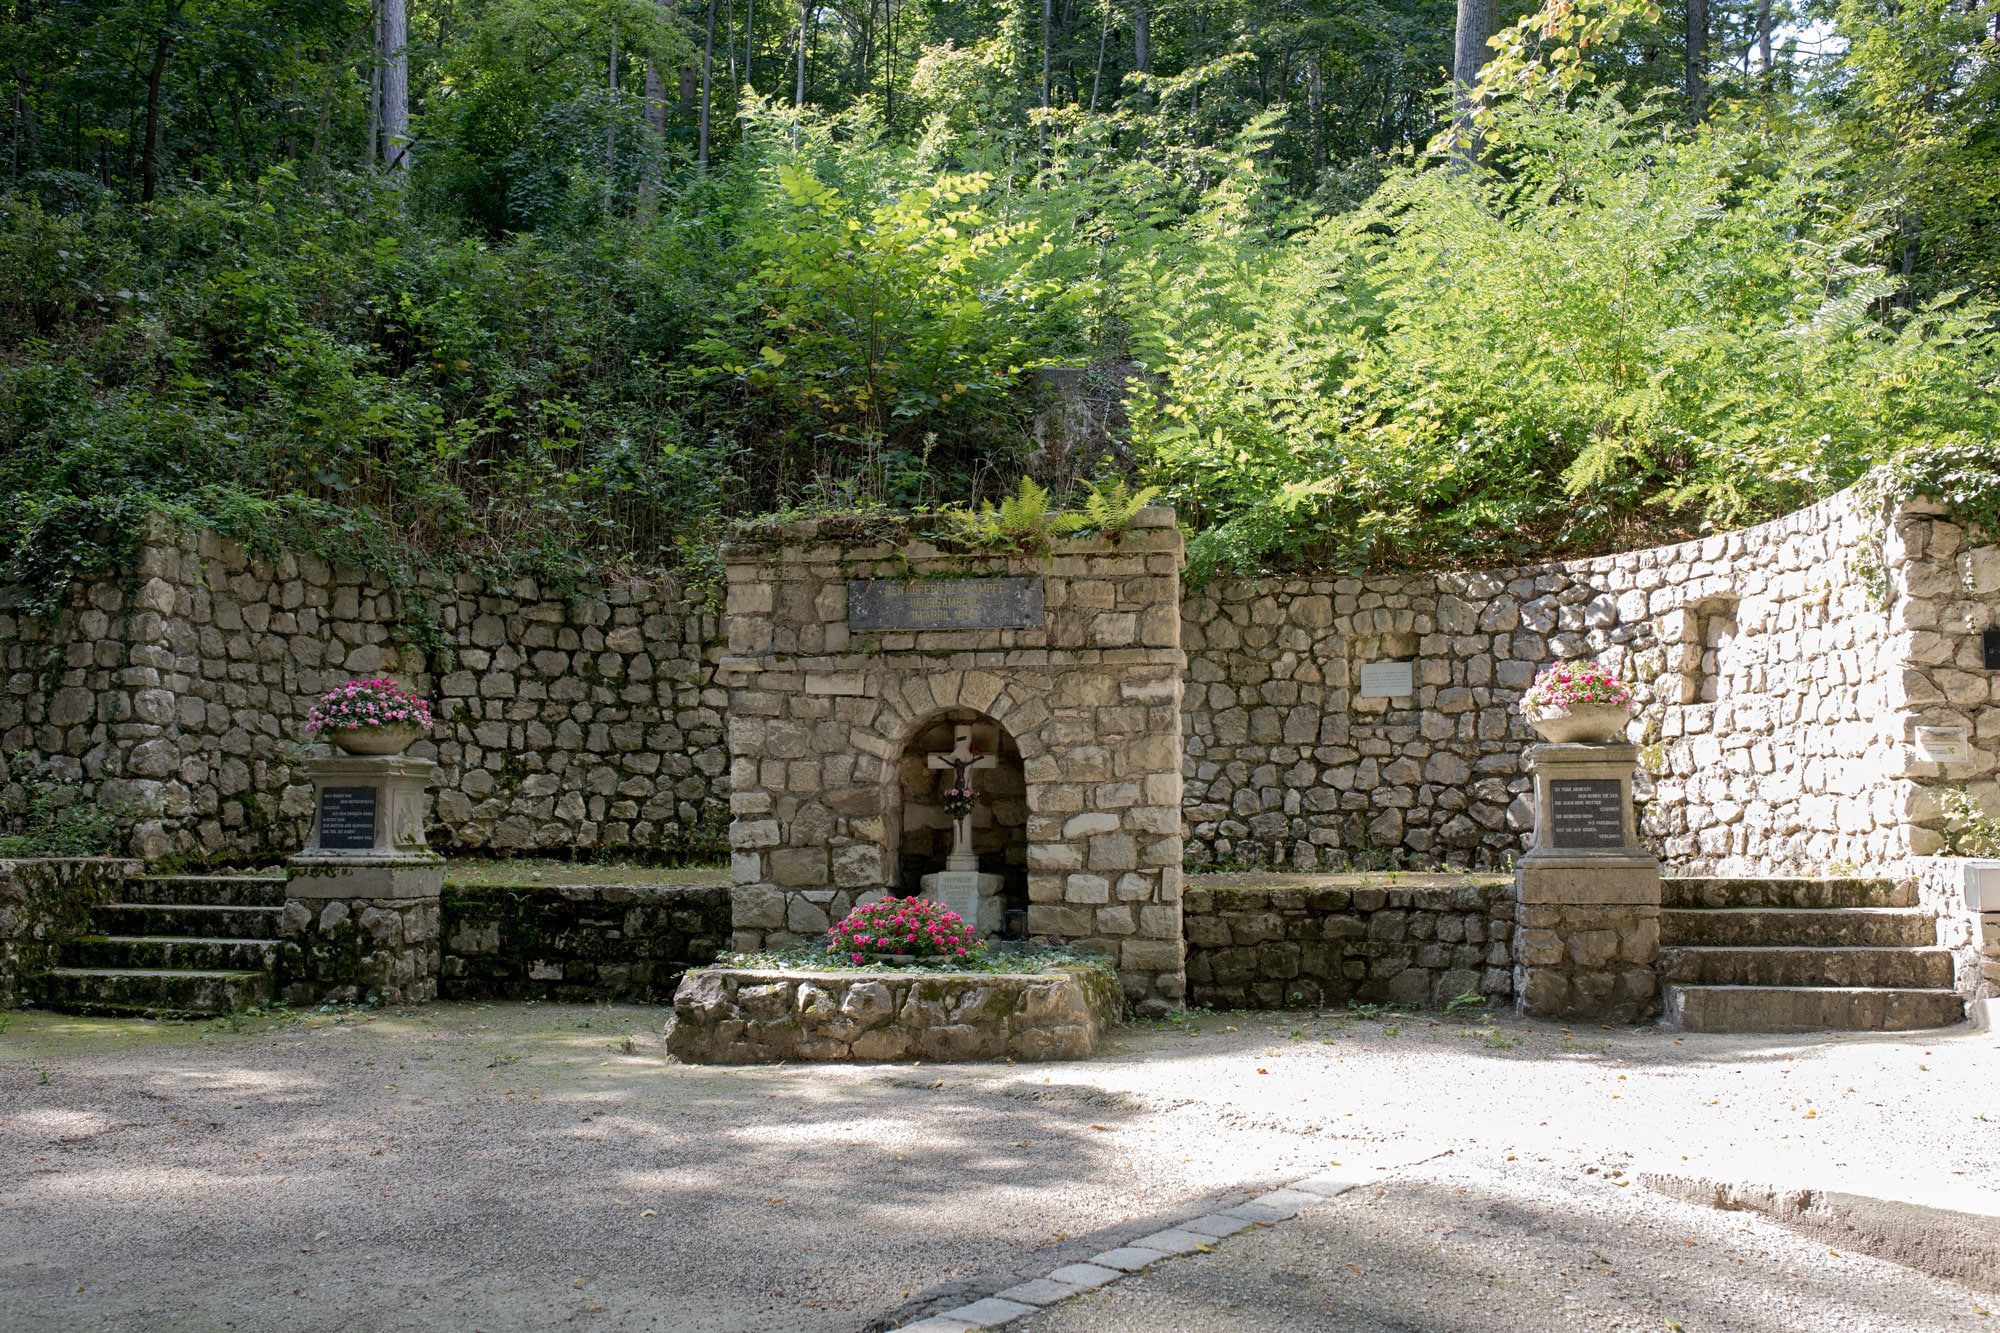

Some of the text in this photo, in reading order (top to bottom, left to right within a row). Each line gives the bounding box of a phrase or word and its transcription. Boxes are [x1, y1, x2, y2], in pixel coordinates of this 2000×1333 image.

[945, 584, 964, 595] DER
[912, 611, 922, 621] IM
[924, 610, 951, 620] APRIL
